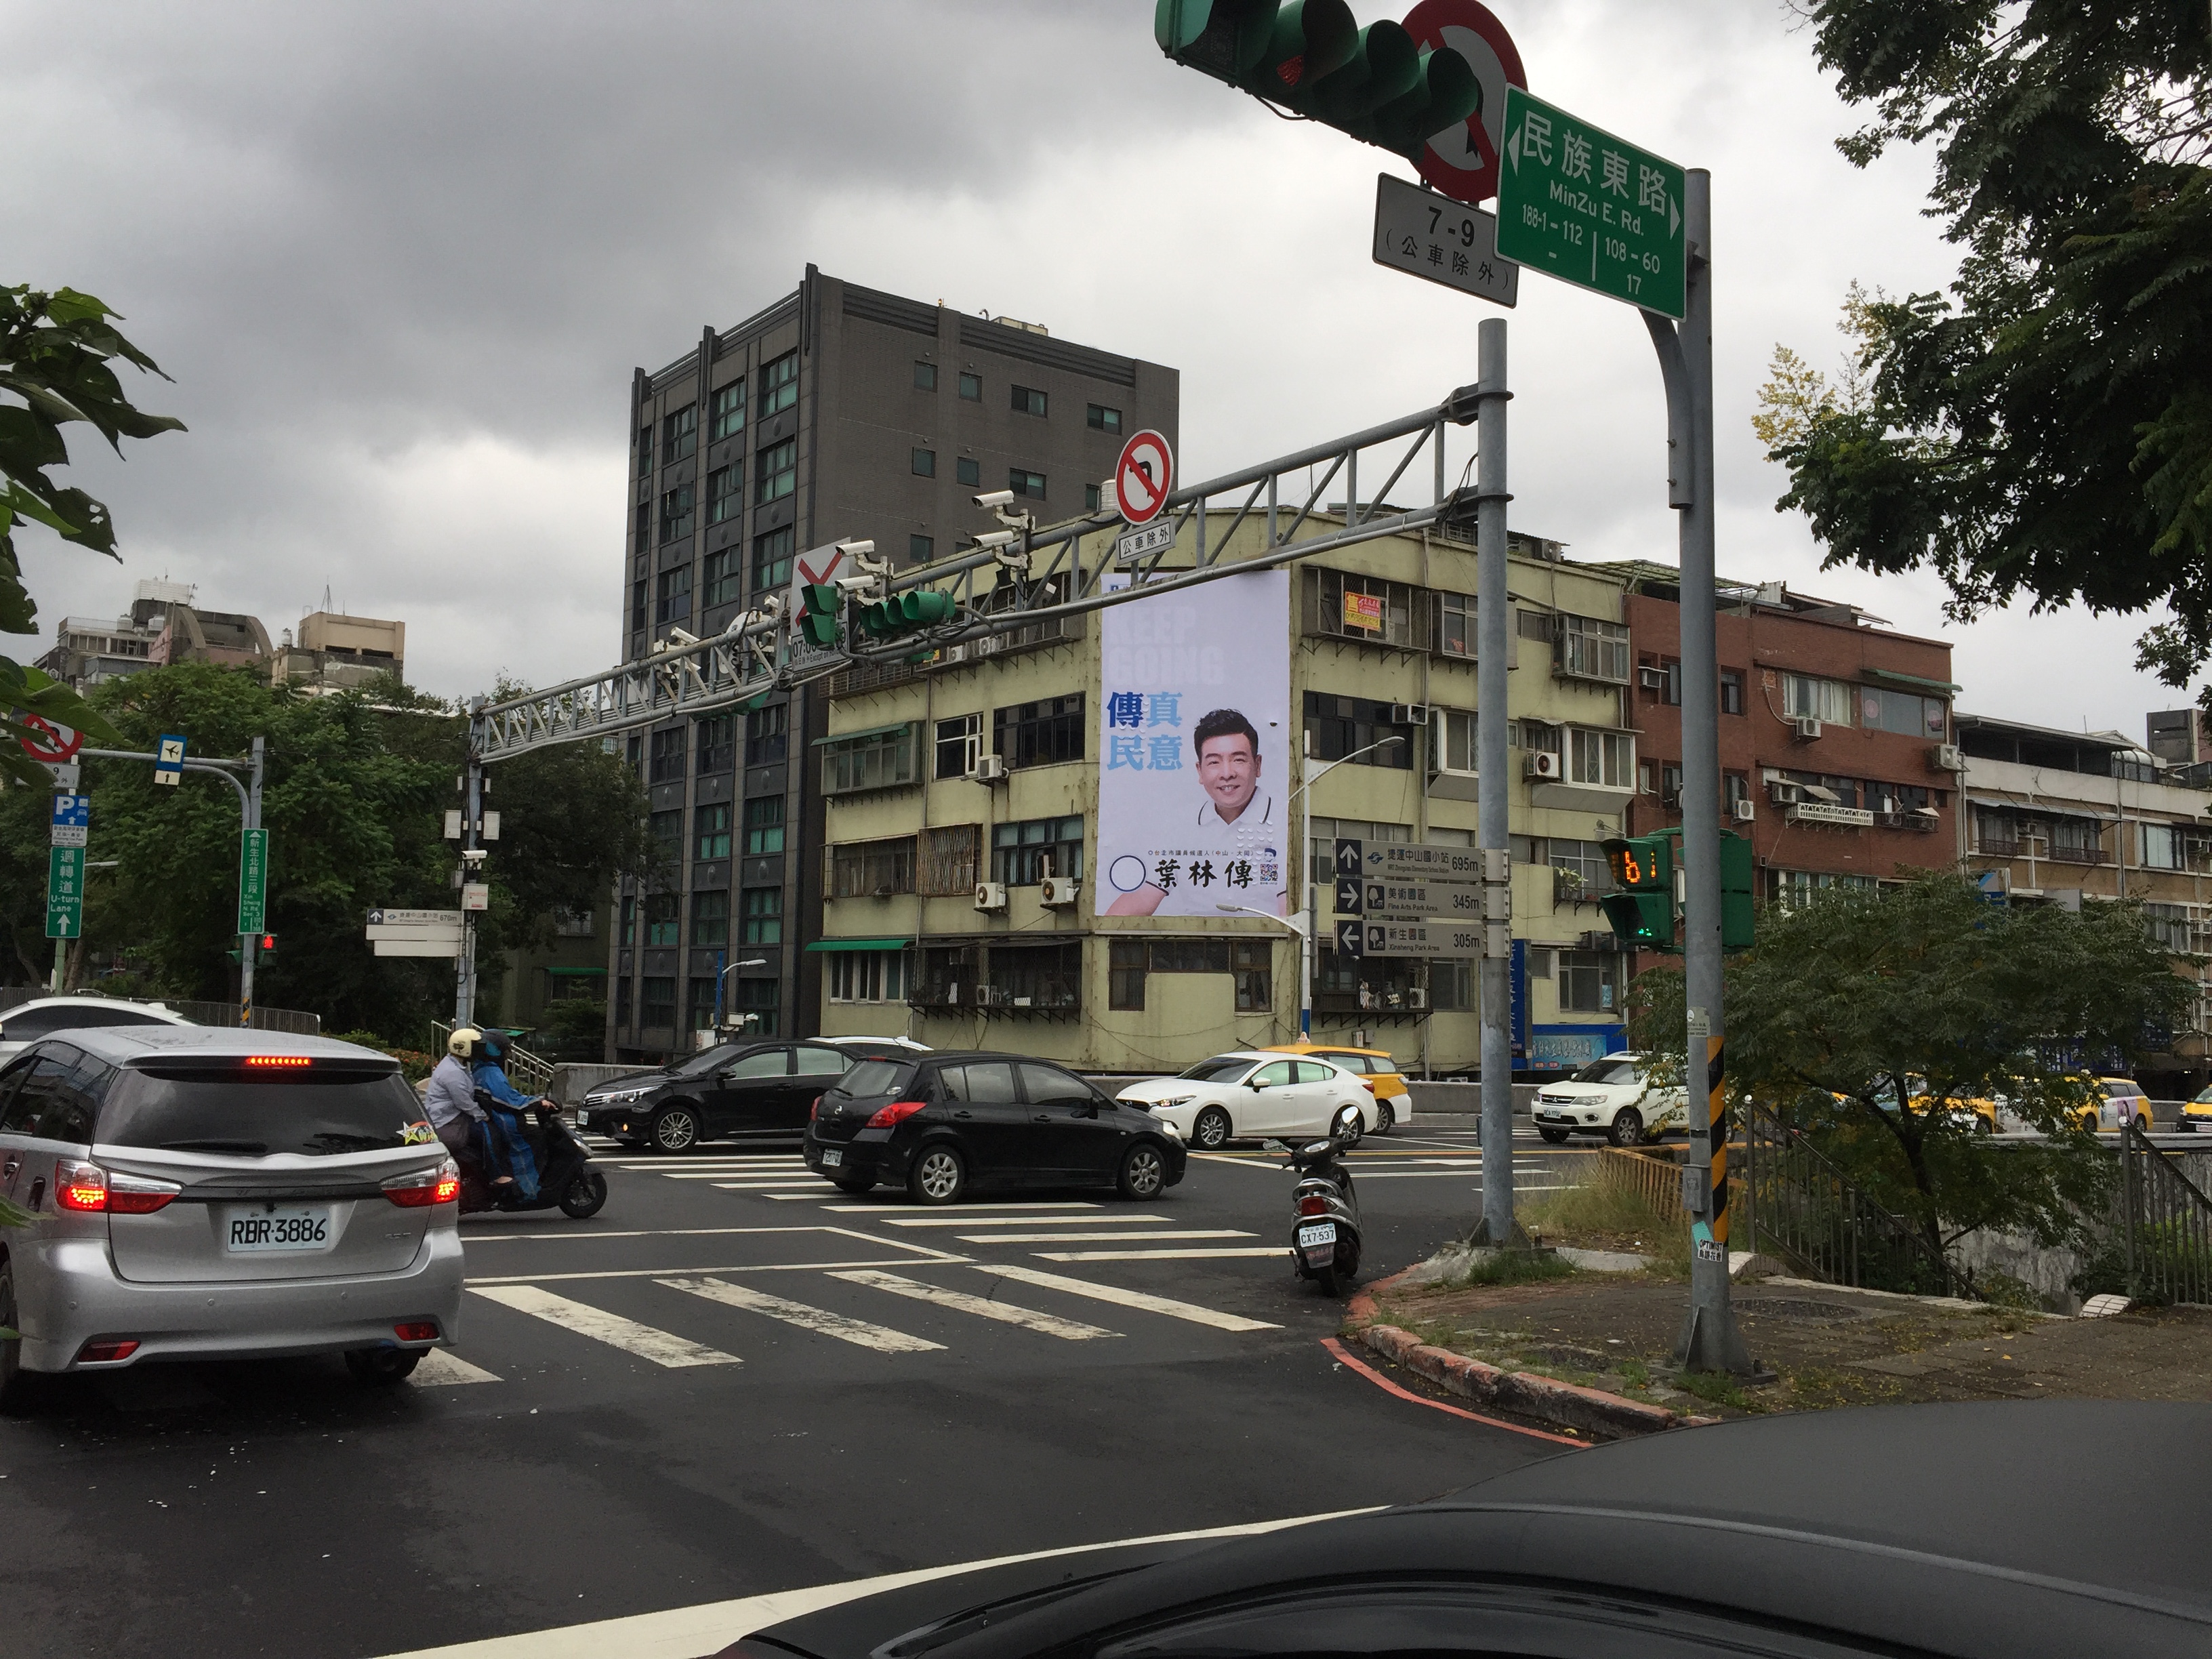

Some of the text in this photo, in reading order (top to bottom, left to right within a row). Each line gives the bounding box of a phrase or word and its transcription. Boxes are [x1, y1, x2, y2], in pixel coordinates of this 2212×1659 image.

[1523, 110, 1667, 217] 民族東路
[1550, 179, 1645, 237] MinZu E. Rd.
[1626, 274, 1641, 295] 17
[1123, 527, 1169, 554] 公車除外
[1107, 691, 1183, 728] 傳真
[1107, 734, 1183, 771] 民意
[248, 838, 260, 894] 新生北路三段
[1154, 858, 1254, 888] 葉林傳
[1452, 857, 1478, 872] 695m
[50, 904, 72, 912] Lane
[51, 895, 80, 903] U-turn
[1453, 894, 1479, 909] 345m
[1453, 933, 1480, 947] 305m
